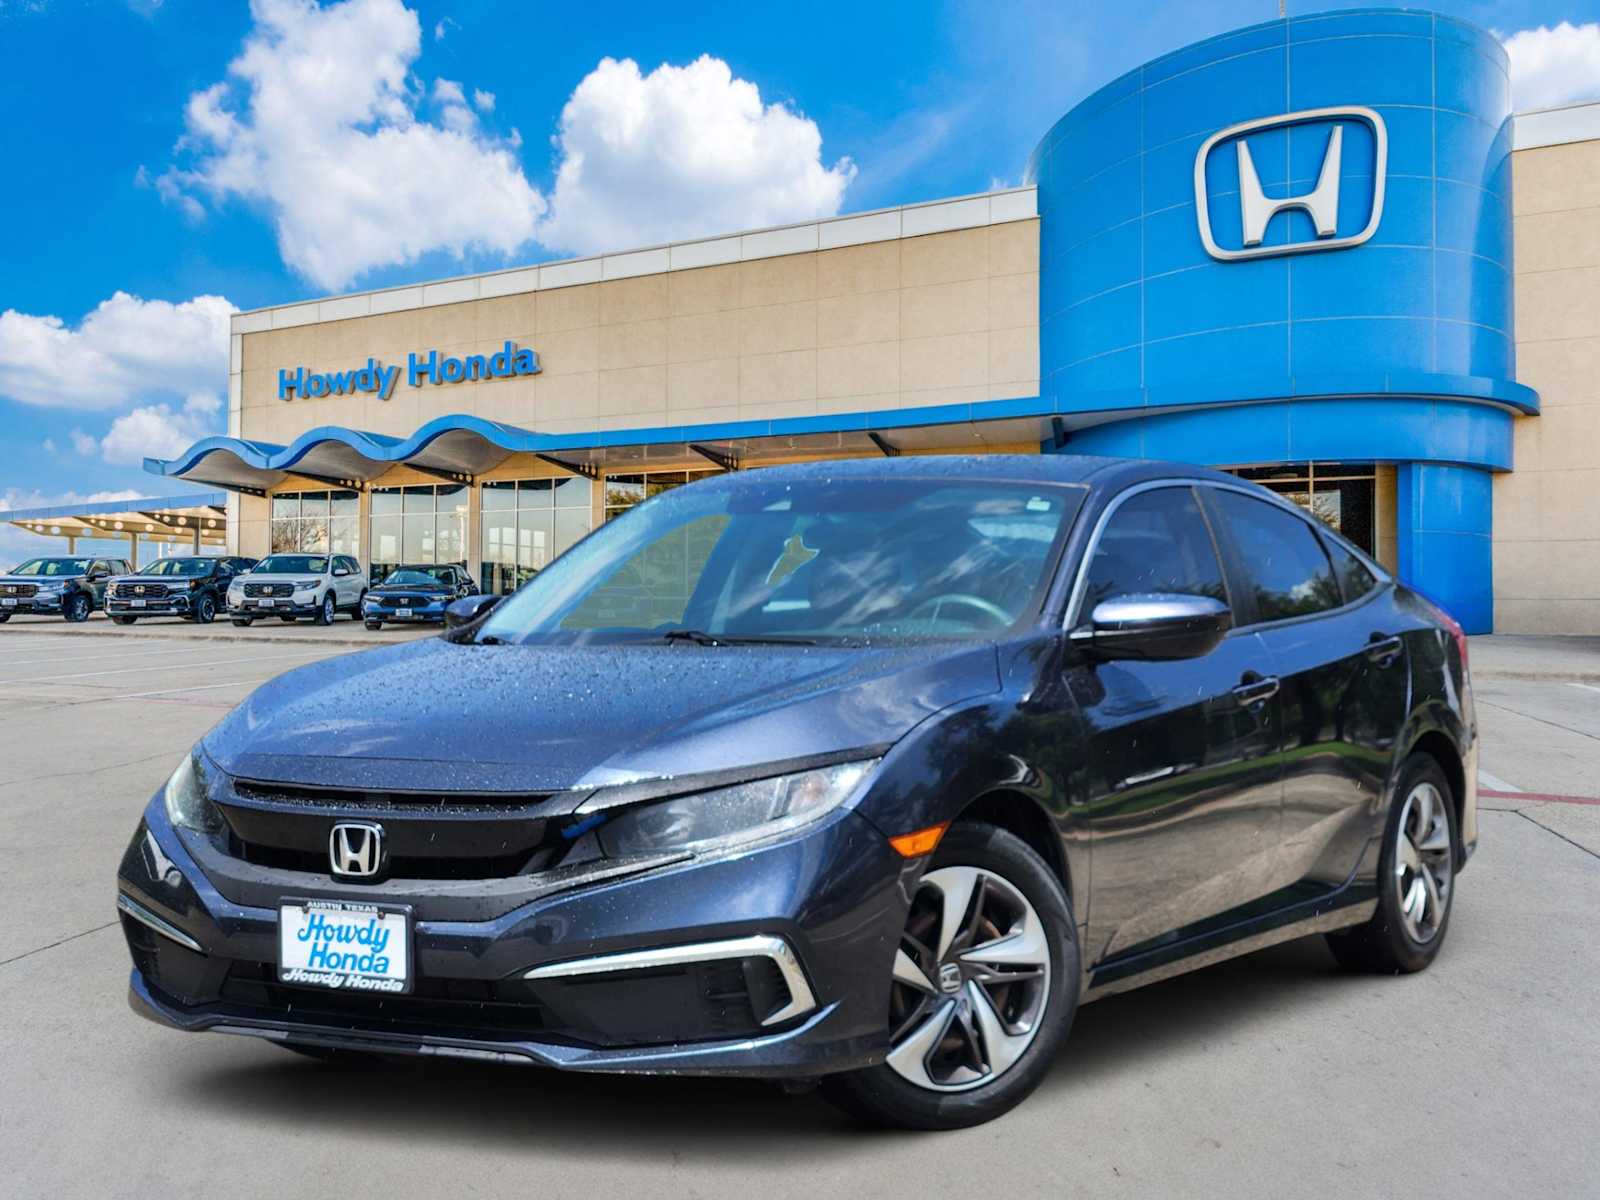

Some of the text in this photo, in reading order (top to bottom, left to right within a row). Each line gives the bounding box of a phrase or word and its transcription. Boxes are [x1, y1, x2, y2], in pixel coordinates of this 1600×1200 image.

[278, 340, 542, 401] Howdy Honda
[306, 901, 379, 913] AUSTIN TEXAS
[297, 912, 390, 954] Howdy
[308, 942, 390, 974] Honda
[282, 968, 405, 992] Howdy Honda
